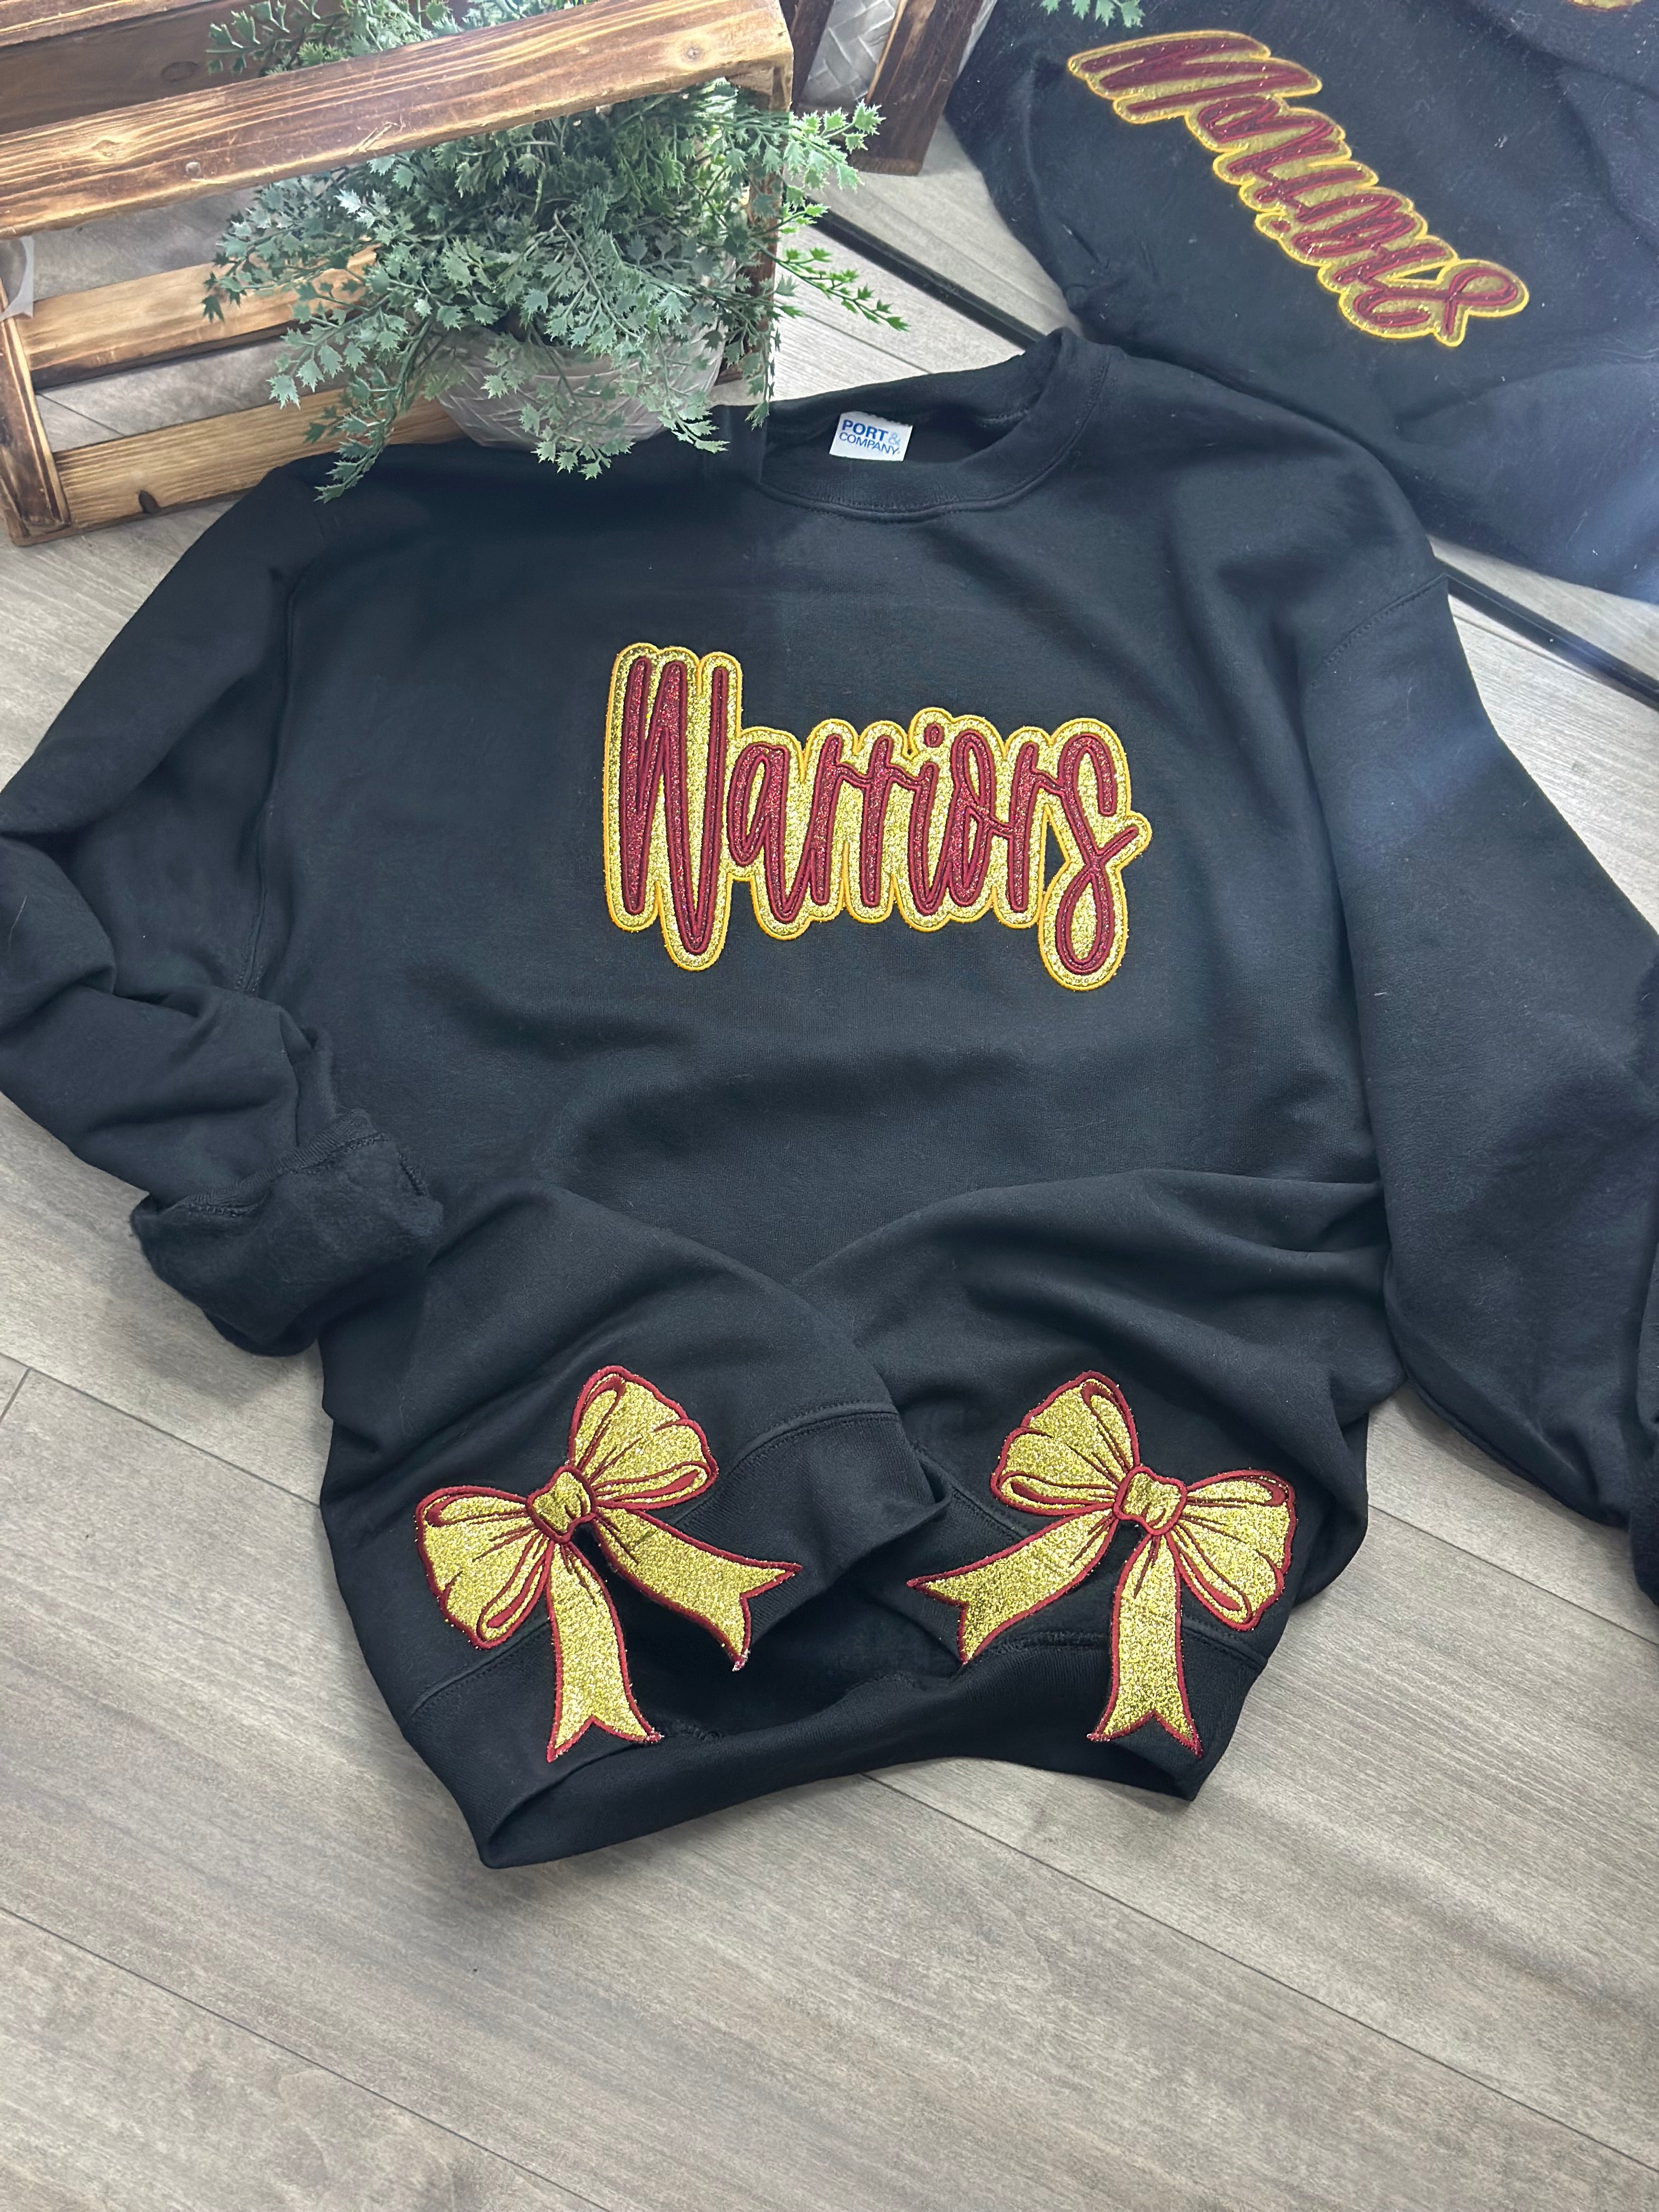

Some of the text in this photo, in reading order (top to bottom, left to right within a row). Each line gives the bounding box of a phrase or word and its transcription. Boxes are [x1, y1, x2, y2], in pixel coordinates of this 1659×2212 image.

[839, 432, 900, 455] COMPANY
[842, 419, 901, 446] PORT &
[618, 656, 1140, 976] Warriors
